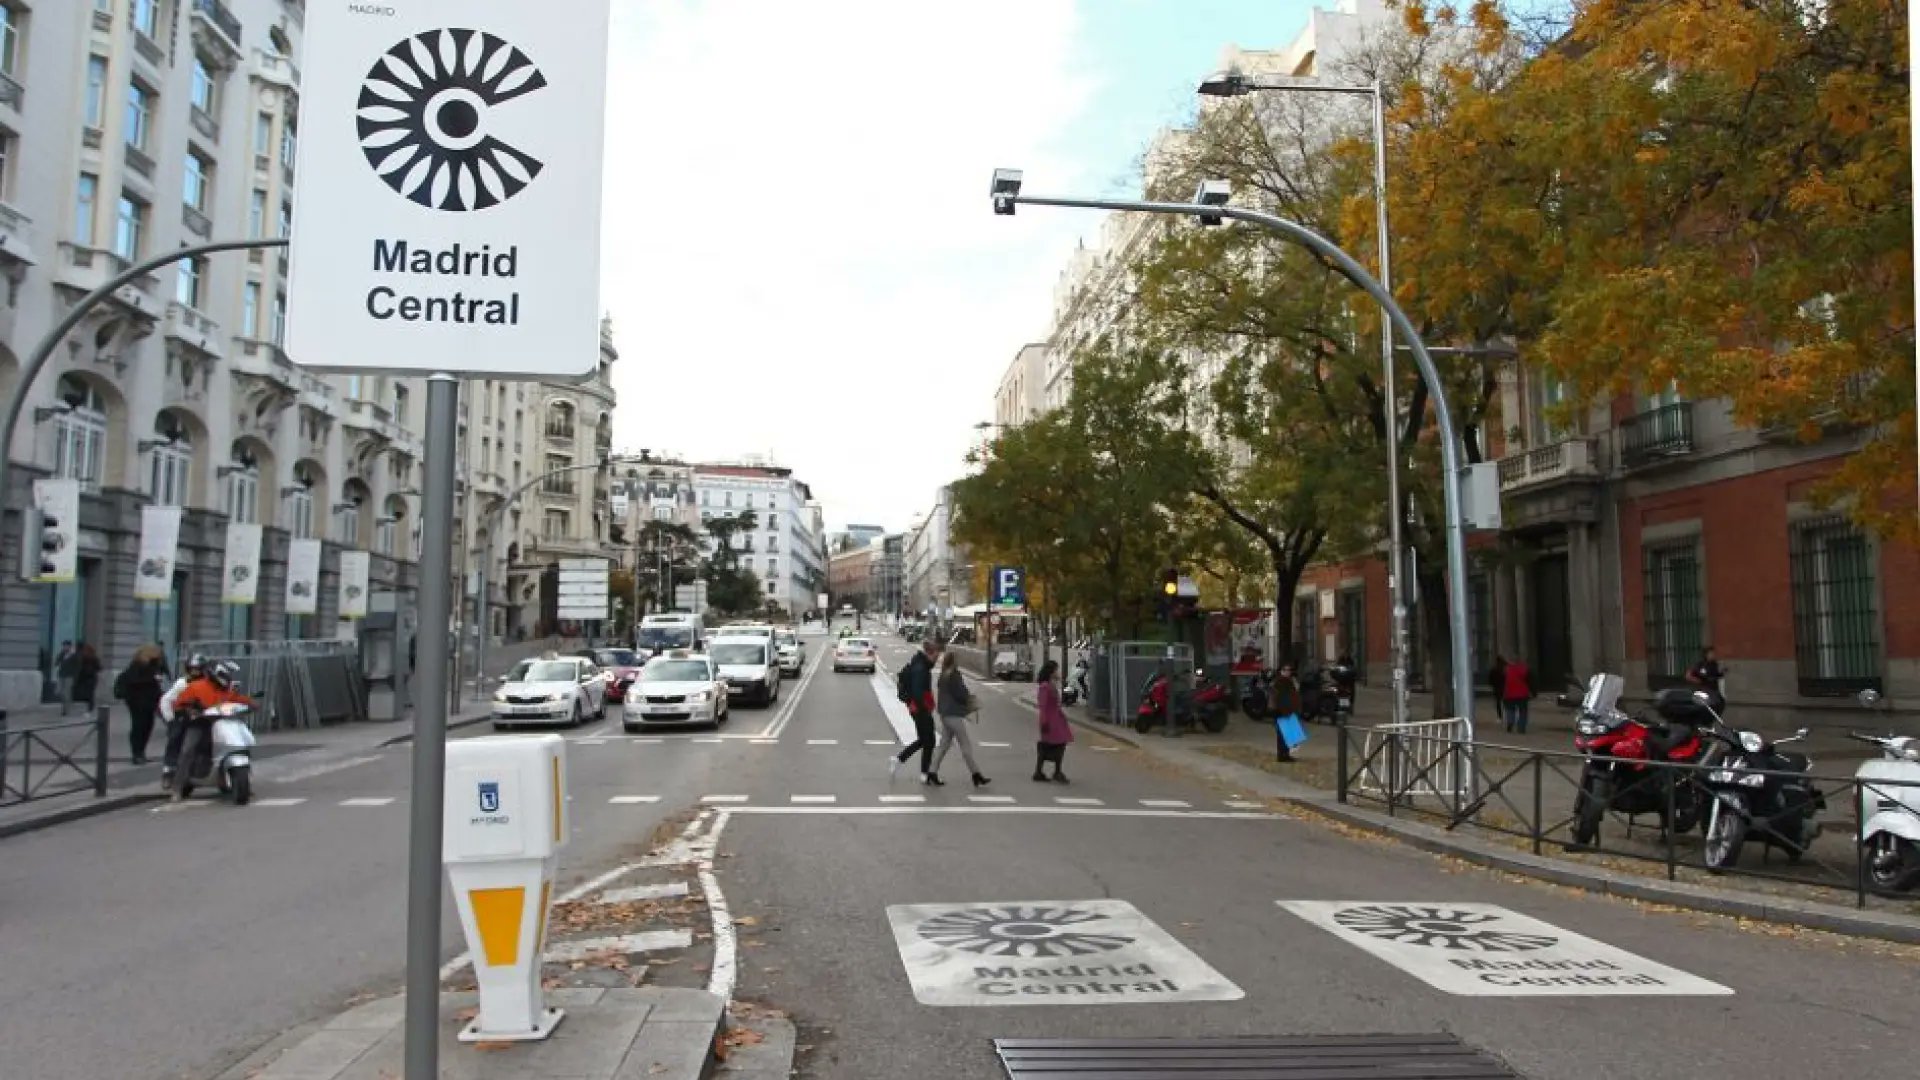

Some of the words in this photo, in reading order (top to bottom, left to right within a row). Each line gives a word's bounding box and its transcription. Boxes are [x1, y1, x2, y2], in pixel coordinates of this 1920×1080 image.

[373, 239, 518, 278] Madrid
[366, 286, 520, 325] Central
[1000, 568, 1019, 598] P
[974, 963, 1156, 979] Madrid
[1447, 958, 1623, 971] Madrid
[978, 979, 1180, 995] Central
[1479, 973, 1667, 986] Central
